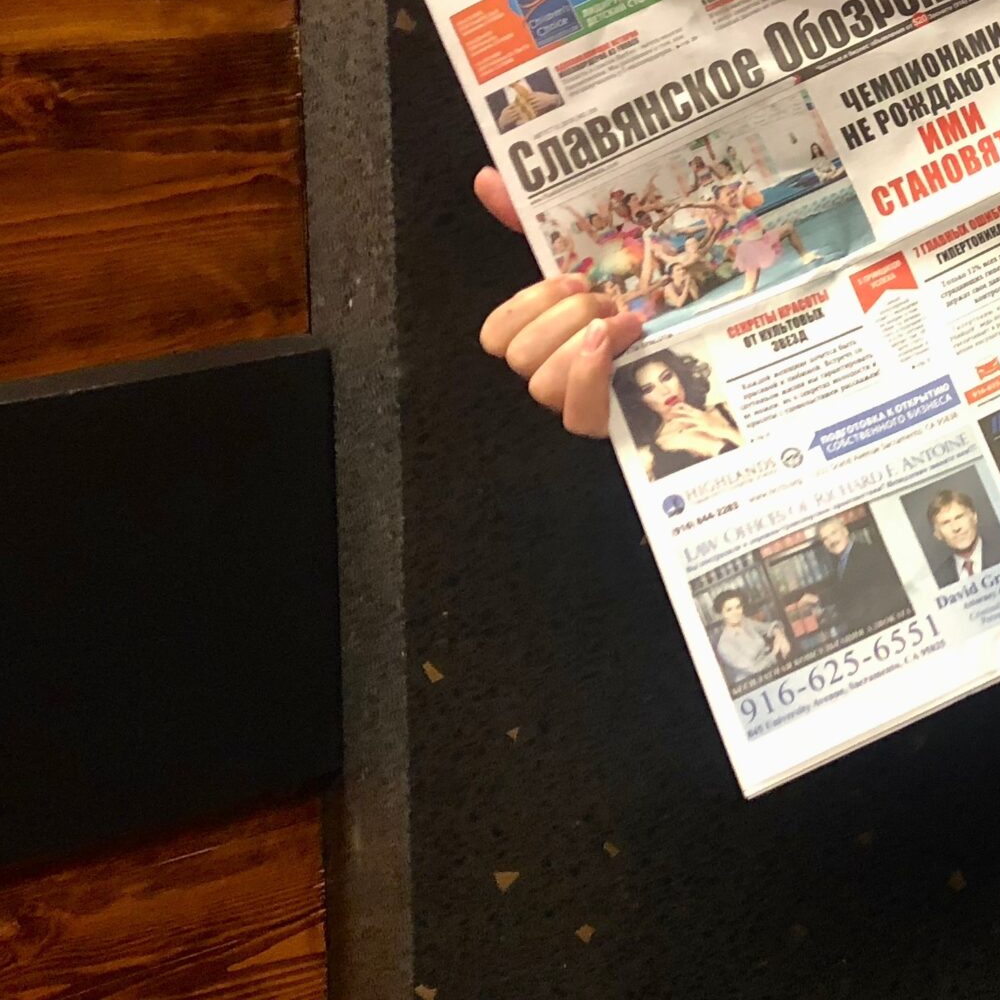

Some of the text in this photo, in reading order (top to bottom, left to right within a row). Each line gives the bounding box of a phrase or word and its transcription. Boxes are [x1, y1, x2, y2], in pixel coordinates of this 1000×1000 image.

[912, 15, 929, 27] $20
[505, 43, 768, 196] Славянское
[839, 115, 877, 151] НЕ
[916, 100, 987, 155] ИМИ
[911, 246, 921, 259] 7
[918, 221, 970, 255] ГЛАВНЫХ
[724, 287, 831, 340] СЕКРЕТЫ КРАСОТЫ
[741, 305, 826, 349] ОТ КУЛЬТОВЫХ
[769, 328, 809, 354] ЗВЕЗД
[818, 409, 886, 447] ПОДГОТОВКА
[884, 405, 895, 418] К
[892, 381, 951, 414] ОТКРЫТИЮ
[824, 412, 907, 455] СОБСТВЕННОГО
[904, 391, 954, 420] БИЗНЕСА
[898, 431, 970, 471] ANTOINE
[684, 455, 778, 504] HIGHLANDS
[934, 581, 979, 610] David
[736, 612, 942, 726] 916-625-6551
